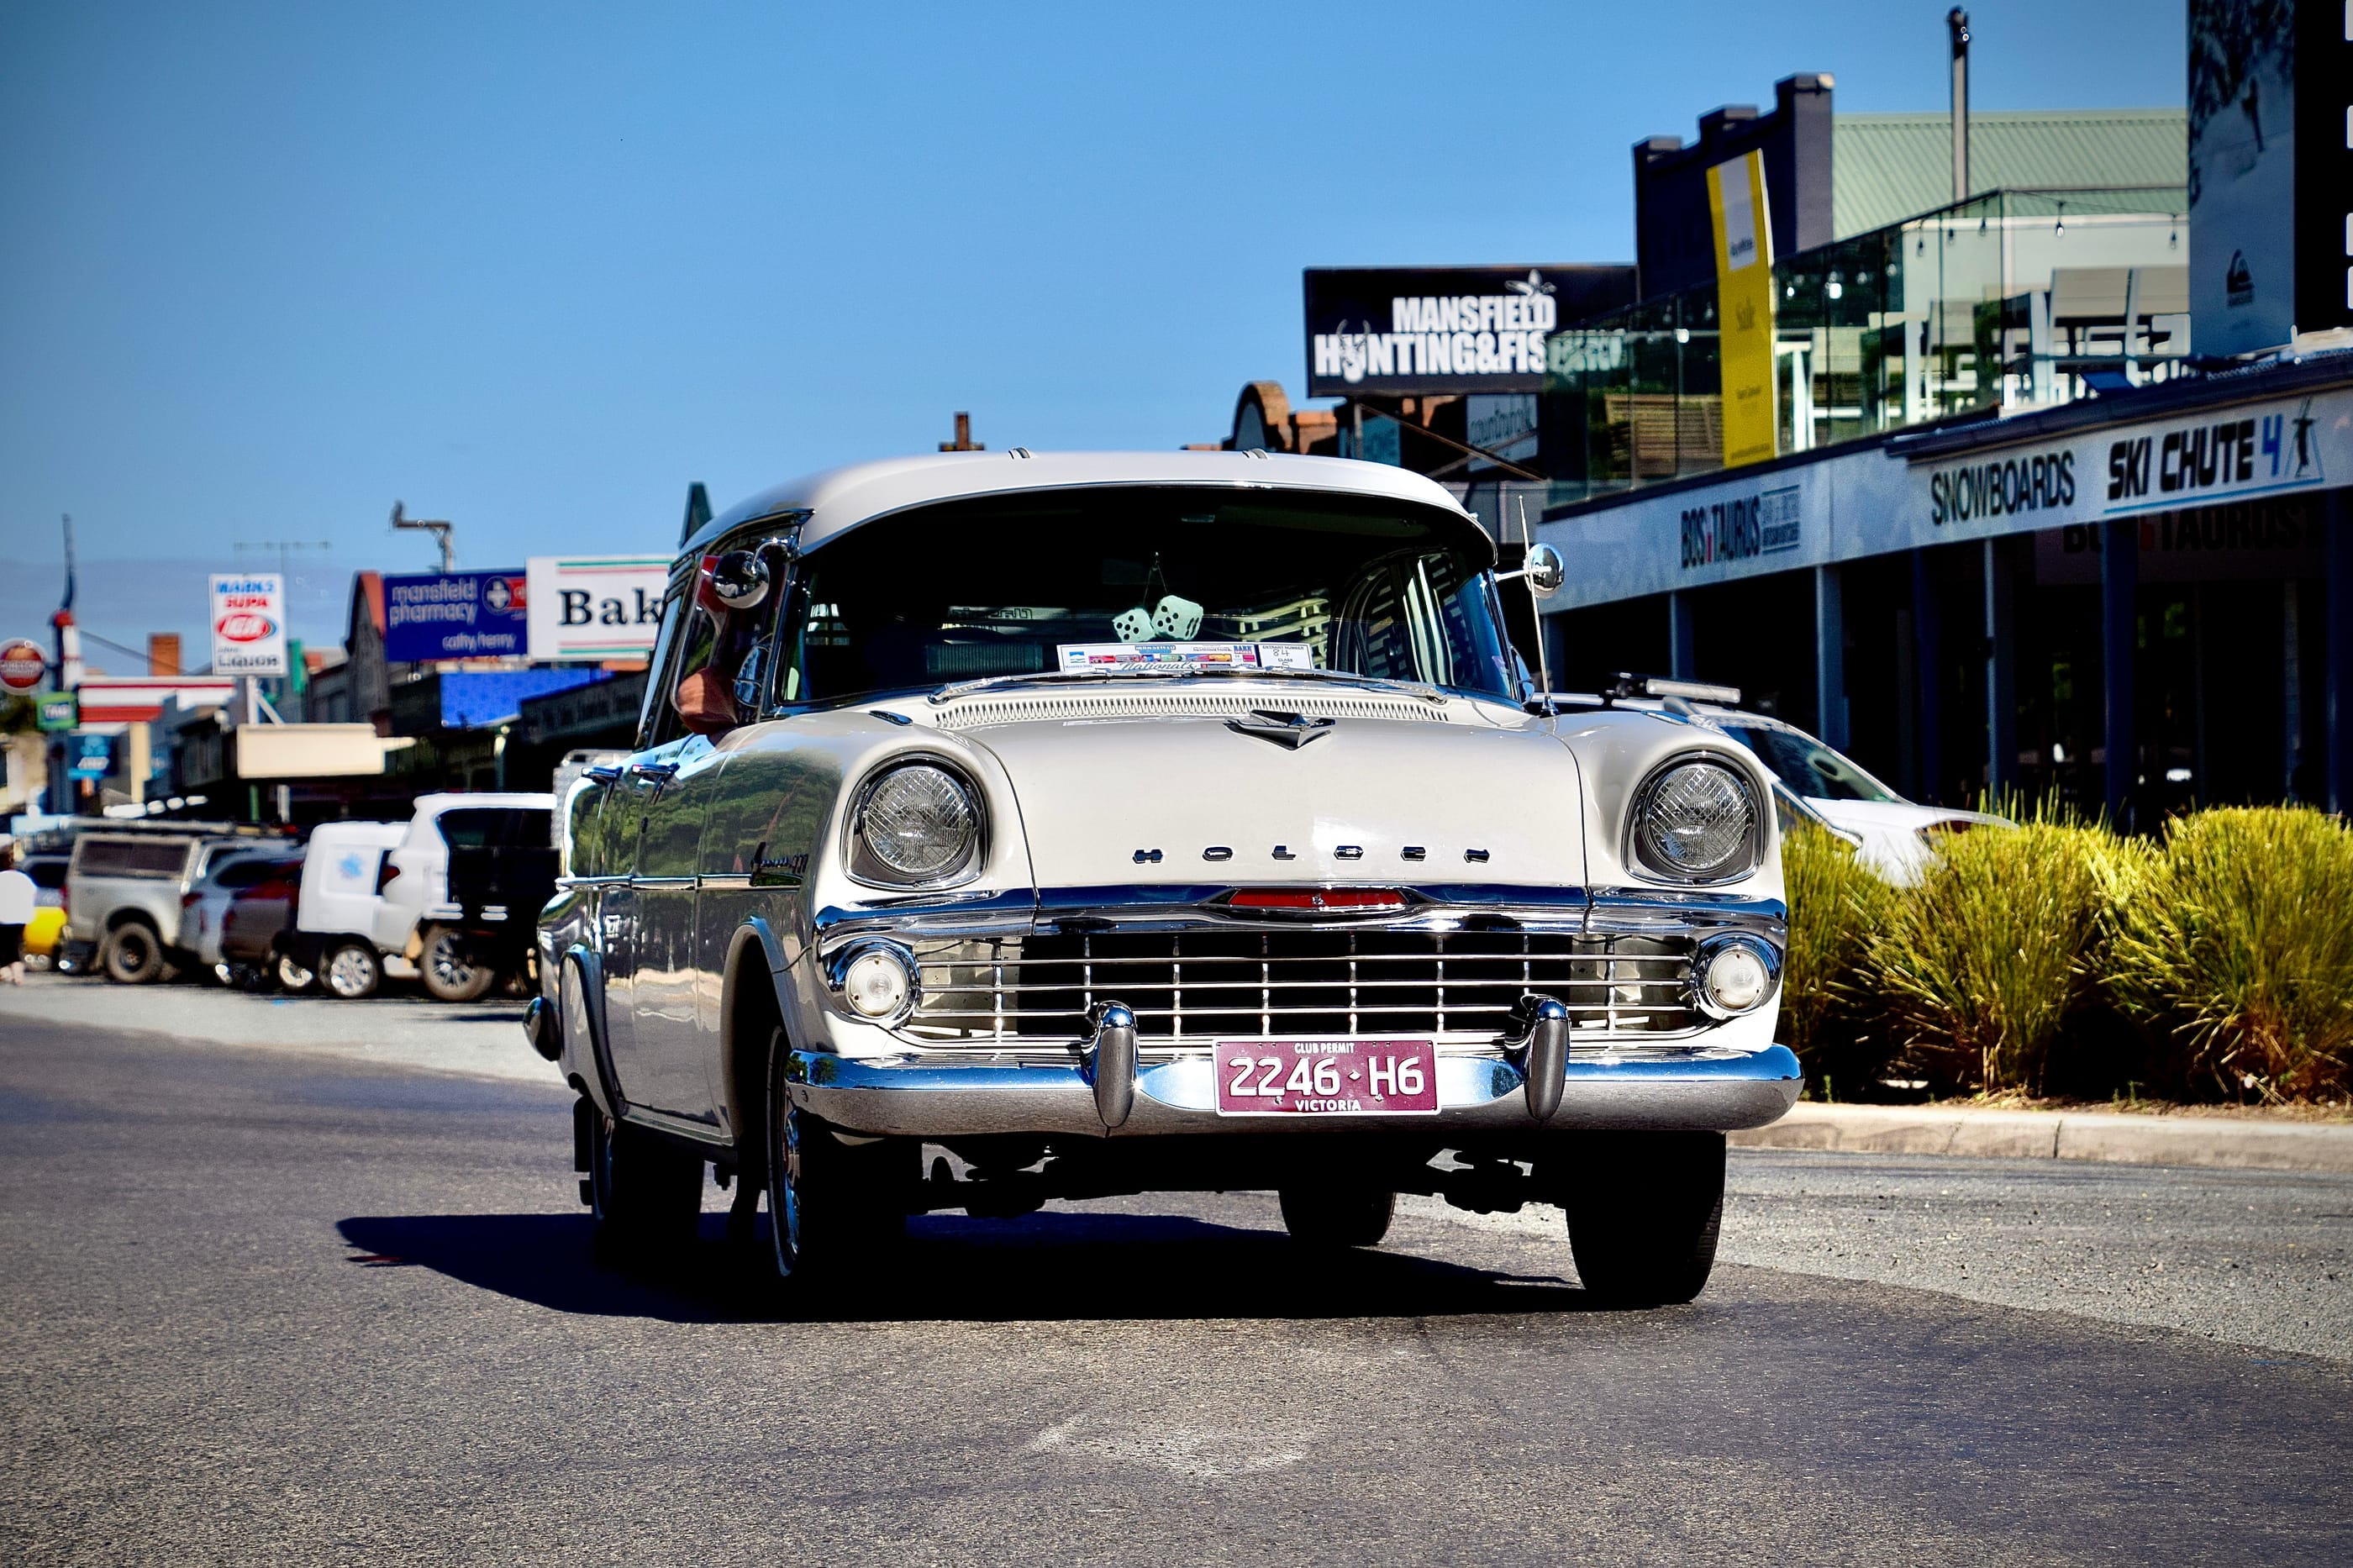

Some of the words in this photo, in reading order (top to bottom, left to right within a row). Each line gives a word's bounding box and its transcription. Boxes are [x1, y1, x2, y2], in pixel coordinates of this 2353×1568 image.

[1392, 295, 1556, 332] MANSFIELD
[2108, 436, 2151, 500] SKI
[2160, 419, 2256, 492] CHUTE
[2261, 414, 2283, 477] 4
[1931, 450, 2076, 526] SNOWBOARDS
[1711, 494, 1761, 562] TAURUS
[392, 577, 478, 603] mansfield
[389, 602, 478, 628] pharmacy
[1132, 845, 1491, 864] HOLDEN
[1294, 1042, 1319, 1054] CLUB
[1320, 1042, 1355, 1054] PERMIT
[1228, 1056, 1341, 1097] 2246
[1367, 1055, 1426, 1096] H6
[1294, 1099, 1362, 1112] VICTORIA
